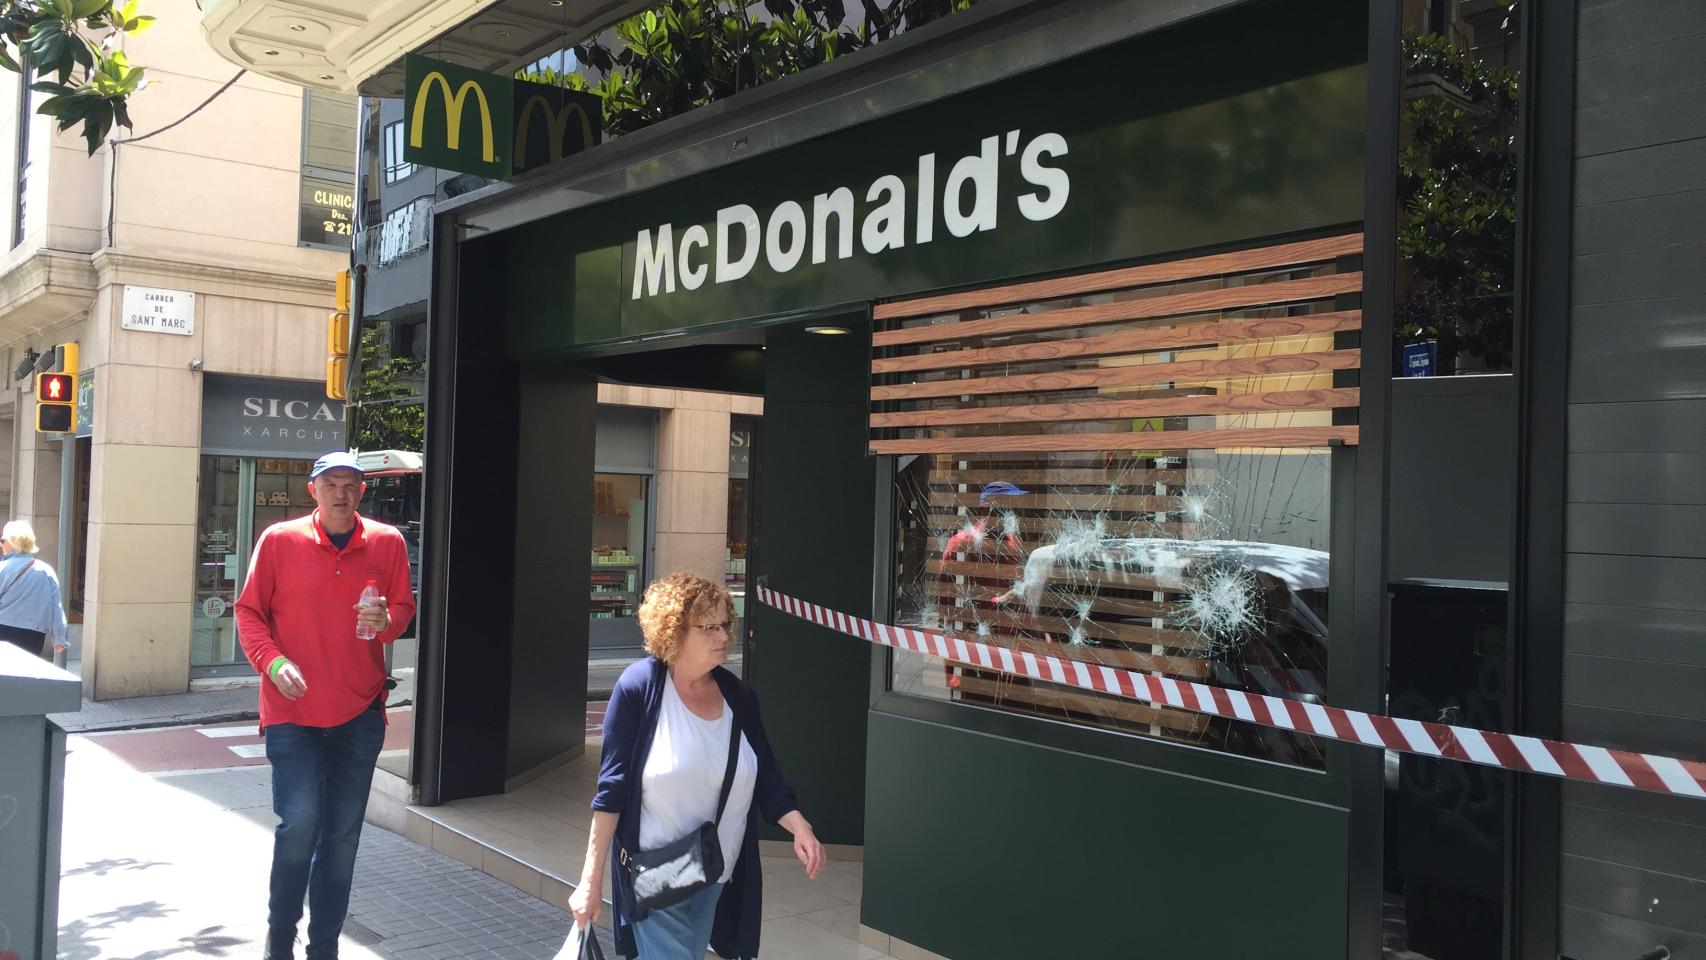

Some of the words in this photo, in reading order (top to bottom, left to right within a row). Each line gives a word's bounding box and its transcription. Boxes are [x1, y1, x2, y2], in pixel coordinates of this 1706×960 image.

[410, 71, 494, 163] M
[632, 129, 1070, 300] McDonald's
[337, 222, 353, 236] 21
[144, 293, 174, 303] CARRER
[154, 305, 164, 313] DE
[131, 314, 156, 326] SANT
[161, 317, 186, 329] MARC
[243, 397, 346, 422] SICA
[242, 426, 340, 440] XARCUT
